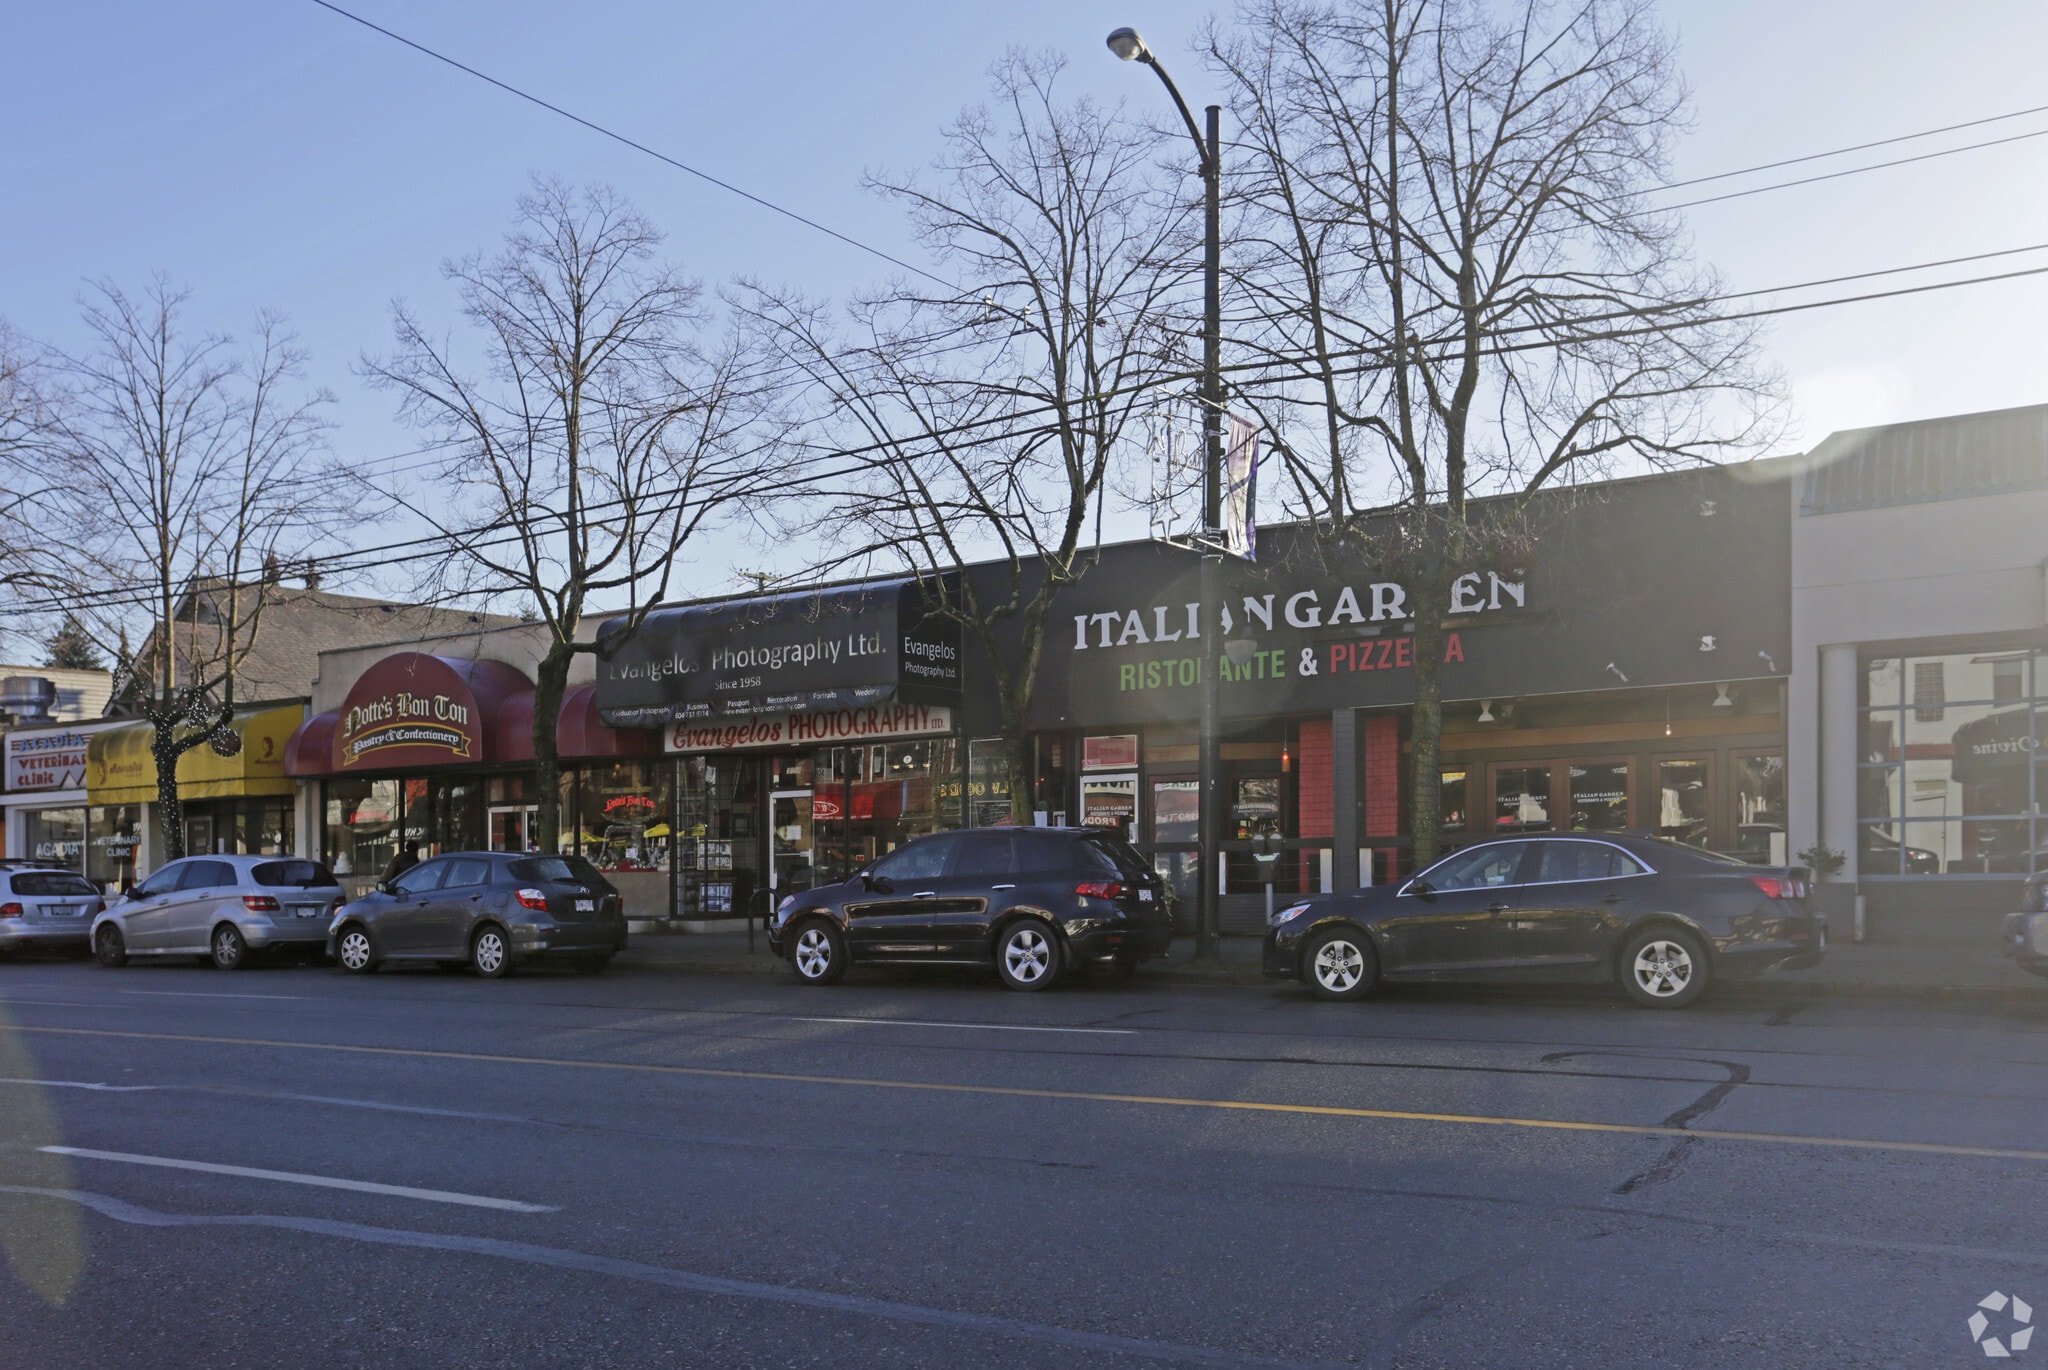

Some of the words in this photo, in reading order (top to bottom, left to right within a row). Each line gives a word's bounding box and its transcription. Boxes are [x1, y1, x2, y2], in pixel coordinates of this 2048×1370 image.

[1074, 594, 1276, 650] ITALIN
[1284, 571, 1525, 628] GAREN
[712, 634, 841, 670] Photography
[848, 632, 887, 657] Ltd.
[904, 637, 955, 660] Evangelos
[904, 662, 944, 677] Photography
[1120, 650, 1286, 691] RISTOANTE
[1299, 647, 1318, 676] &
[1330, 633, 1465, 673] PIZZEA
[715, 680, 738, 690] Since
[739, 676, 761, 688] 1958
[396, 692, 430, 721] Bon
[434, 695, 467, 725] Ton
[396, 729, 459, 745] Confectionery
[673, 716, 782, 749] Evangelos
[788, 706, 930, 740] PHOTOGRAPHY
[96, 835, 140, 846] VETERINARY
[106, 848, 131, 857] CLINIC
